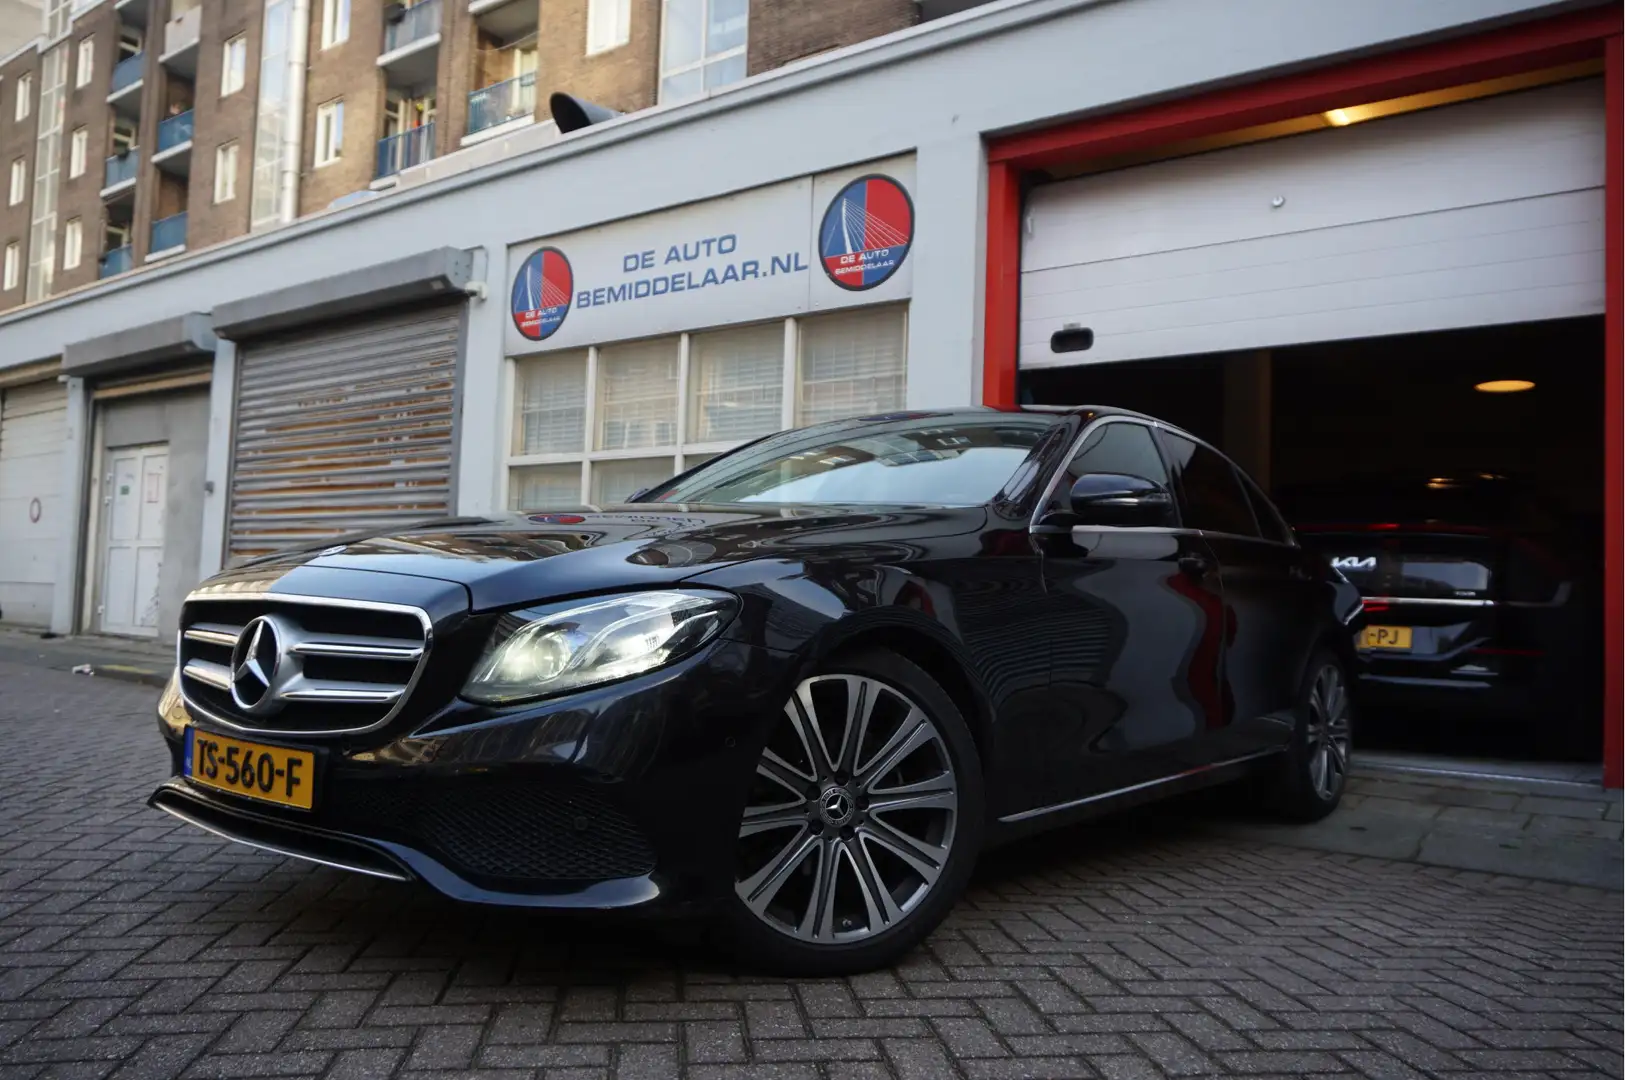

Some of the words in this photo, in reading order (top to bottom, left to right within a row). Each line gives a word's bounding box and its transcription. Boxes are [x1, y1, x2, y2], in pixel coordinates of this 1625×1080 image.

[623, 250, 655, 273] DE
[664, 233, 737, 265] AUTO
[840, 254, 856, 264] DE
[858, 249, 890, 261] AUTO
[834, 259, 895, 275] BEMIDDELAAR
[576, 252, 809, 309] BEMIDDELAAR.NL
[1331, 556, 1377, 568] KIA
[1369, 628, 1399, 645] -PJ
[197, 738, 303, 798] TS-560-F
